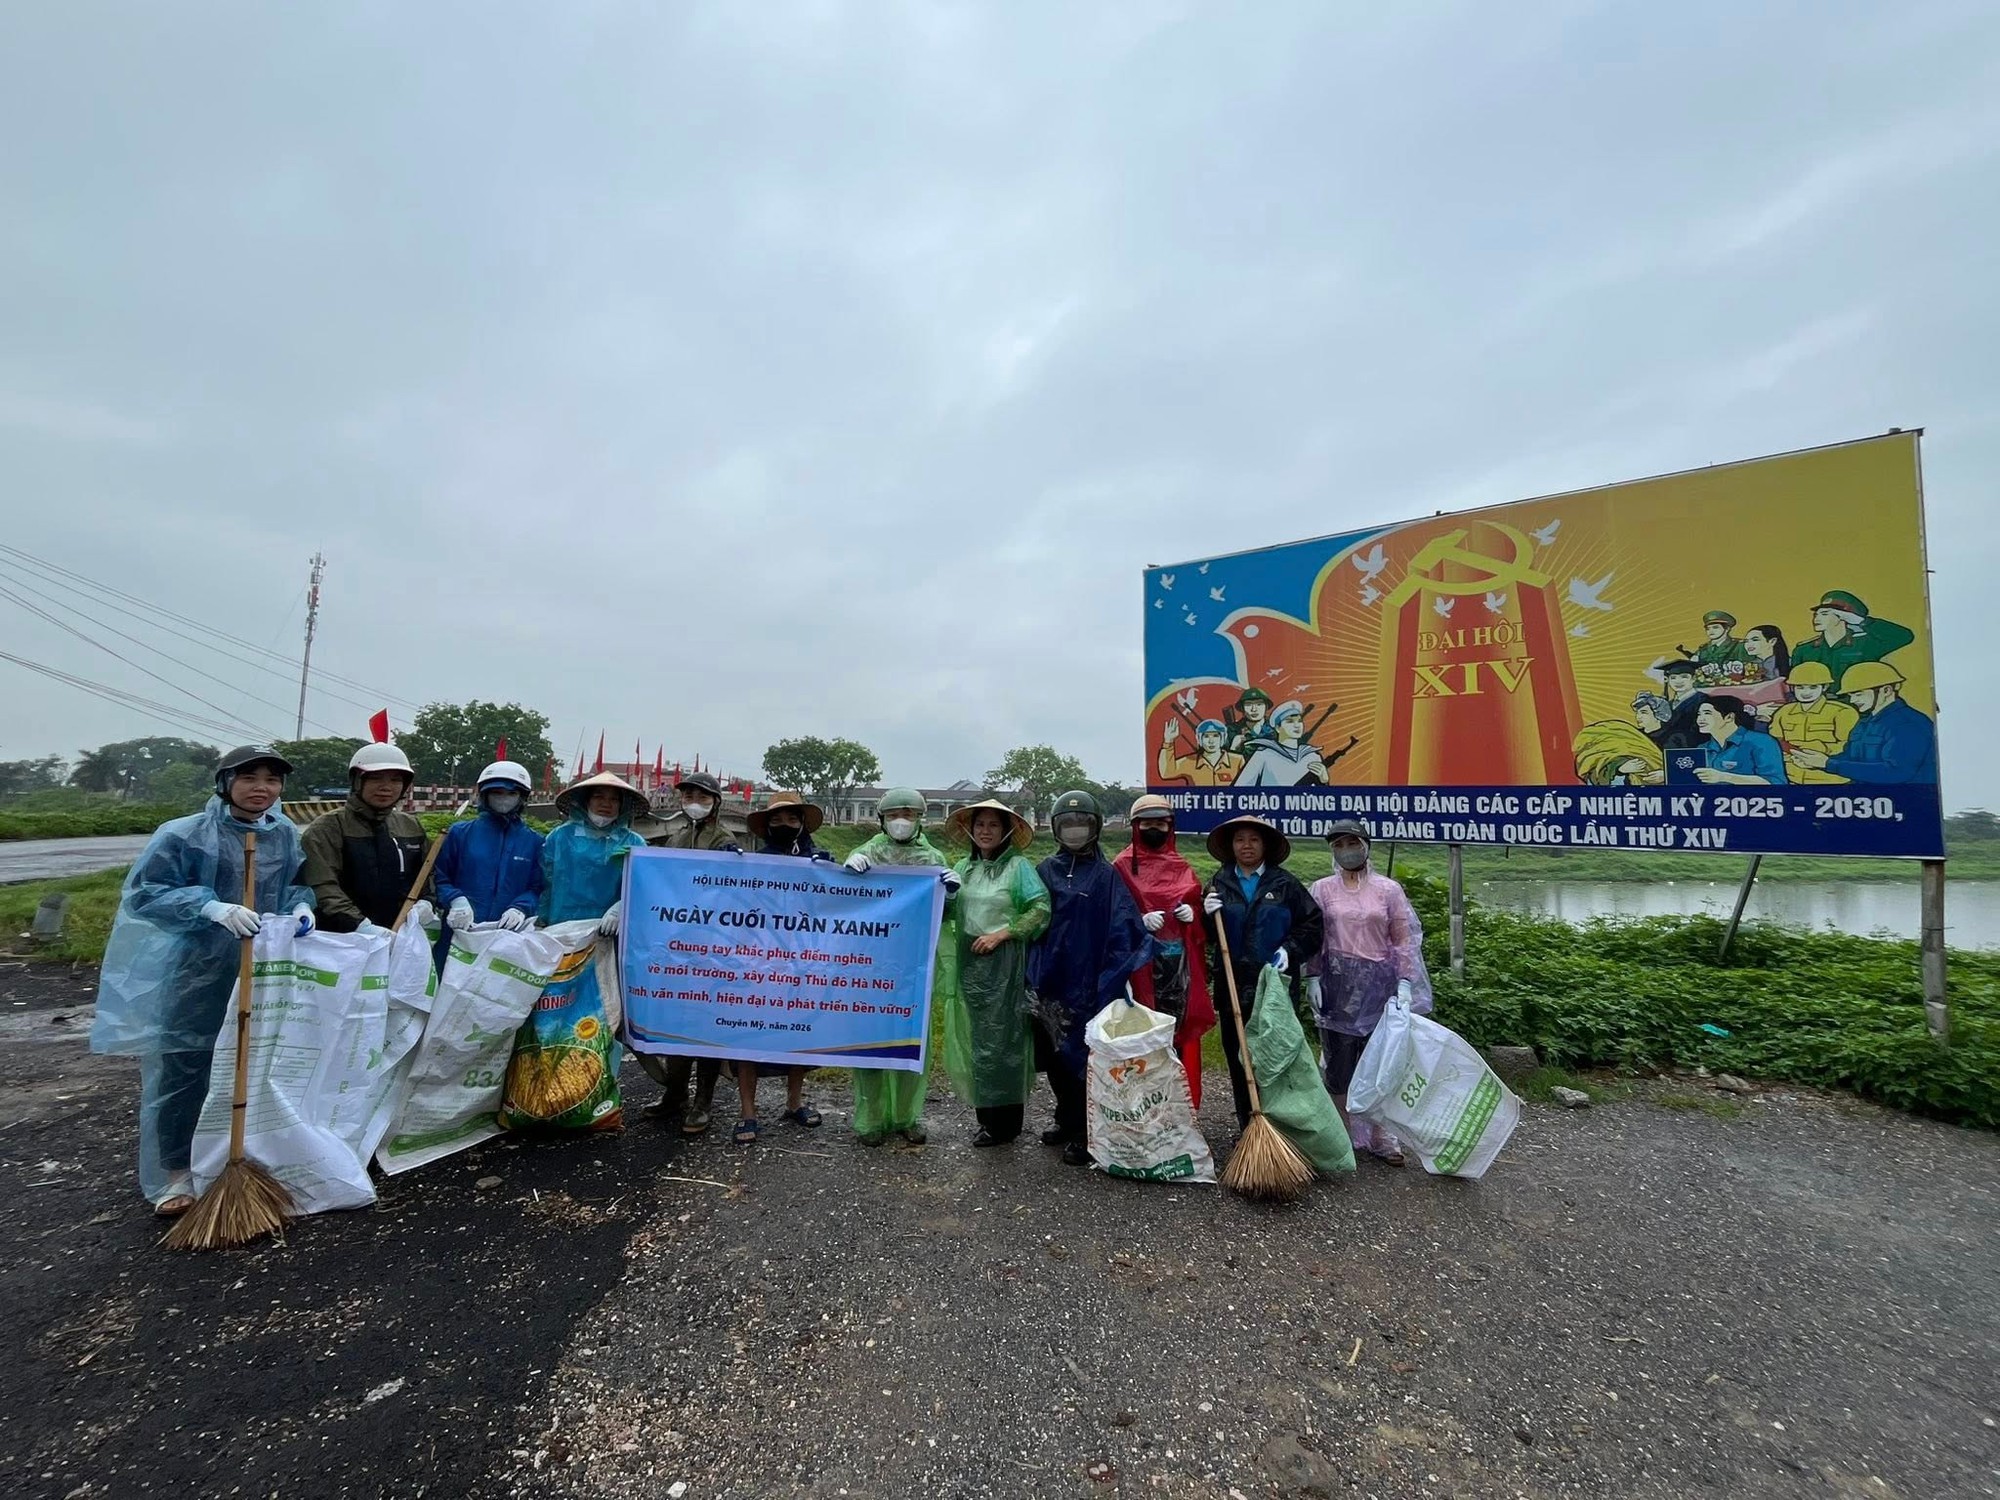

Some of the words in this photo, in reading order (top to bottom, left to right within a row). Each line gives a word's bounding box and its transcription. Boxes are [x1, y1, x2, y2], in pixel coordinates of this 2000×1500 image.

[1419, 630, 1467, 655] ĐẠI
[1473, 618, 1526, 649] HỘI
[1411, 657, 1536, 699] XIV
[1203, 791, 1234, 813] LIỆT
[1238, 792, 1280, 811] CHÀO
[1284, 792, 1336, 812] MỪNG
[1340, 795, 1371, 816] ĐẠI
[1376, 792, 1409, 816] HỘI
[1413, 790, 1470, 814] ĐẢNG
[1476, 792, 1520, 815] CÁC
[1526, 790, 1573, 815] CẤP
[1579, 792, 1663, 820] NHIỆM
[1670, 792, 1705, 817] KỲ
[1714, 797, 1784, 818] 2025
[1815, 797, 1905, 822] 2030,
[1280, 815, 1307, 836] TỚI
[1381, 816, 1436, 839] ĐẢNG
[1440, 819, 1496, 841] TOÀN
[1502, 818, 1563, 844] QUỐC
[1569, 819, 1618, 846] LẦN
[1624, 822, 1678, 847] THỨ
[1682, 827, 1728, 849] XIV
[692, 874, 712, 888] HỘI
[715, 875, 738, 887] LIÊN
[740, 877, 764, 891] HIỆP
[766, 880, 790, 893] PHỤ
[792, 881, 810, 893] NỮ
[812, 883, 827, 894] XÃ
[829, 886, 873, 898] CHUYÊN
[875, 888, 893, 899] MỸ
[718, 907, 767, 929] CUỐI
[771, 911, 827, 934] TUẦN
[668, 939, 709, 956] Chung
[712, 944, 732, 958] tay
[735, 943, 764, 958] khắc
[766, 947, 797, 961] phục
[799, 949, 831, 963] điểm
[833, 952, 874, 967] nghẽn
[647, 963, 661, 975] về
[664, 964, 689, 976] môi
[692, 966, 739, 983] trường,
[743, 969, 766, 984] xây
[768, 971, 801, 987] dựng
[804, 974, 829, 987] Thủ
[831, 976, 848, 988] đô
[851, 978, 869, 989] Hà
[872, 978, 895, 993] Nội
[650, 986, 675, 1000] văn
[677, 989, 713, 1004] minh,
[716, 991, 744, 1007] hiện
[746, 995, 767, 1009] đại
[769, 997, 785, 1008] và
[786, 997, 816, 1011] phát
[819, 999, 849, 1013] triển
[851, 1000, 876, 1014] bền
[715, 1017, 748, 1029] Chuyên
[768, 1023, 789, 1032] năm
[789, 1023, 812, 1032] 2026
[1400, 1071, 1428, 1109] 834
